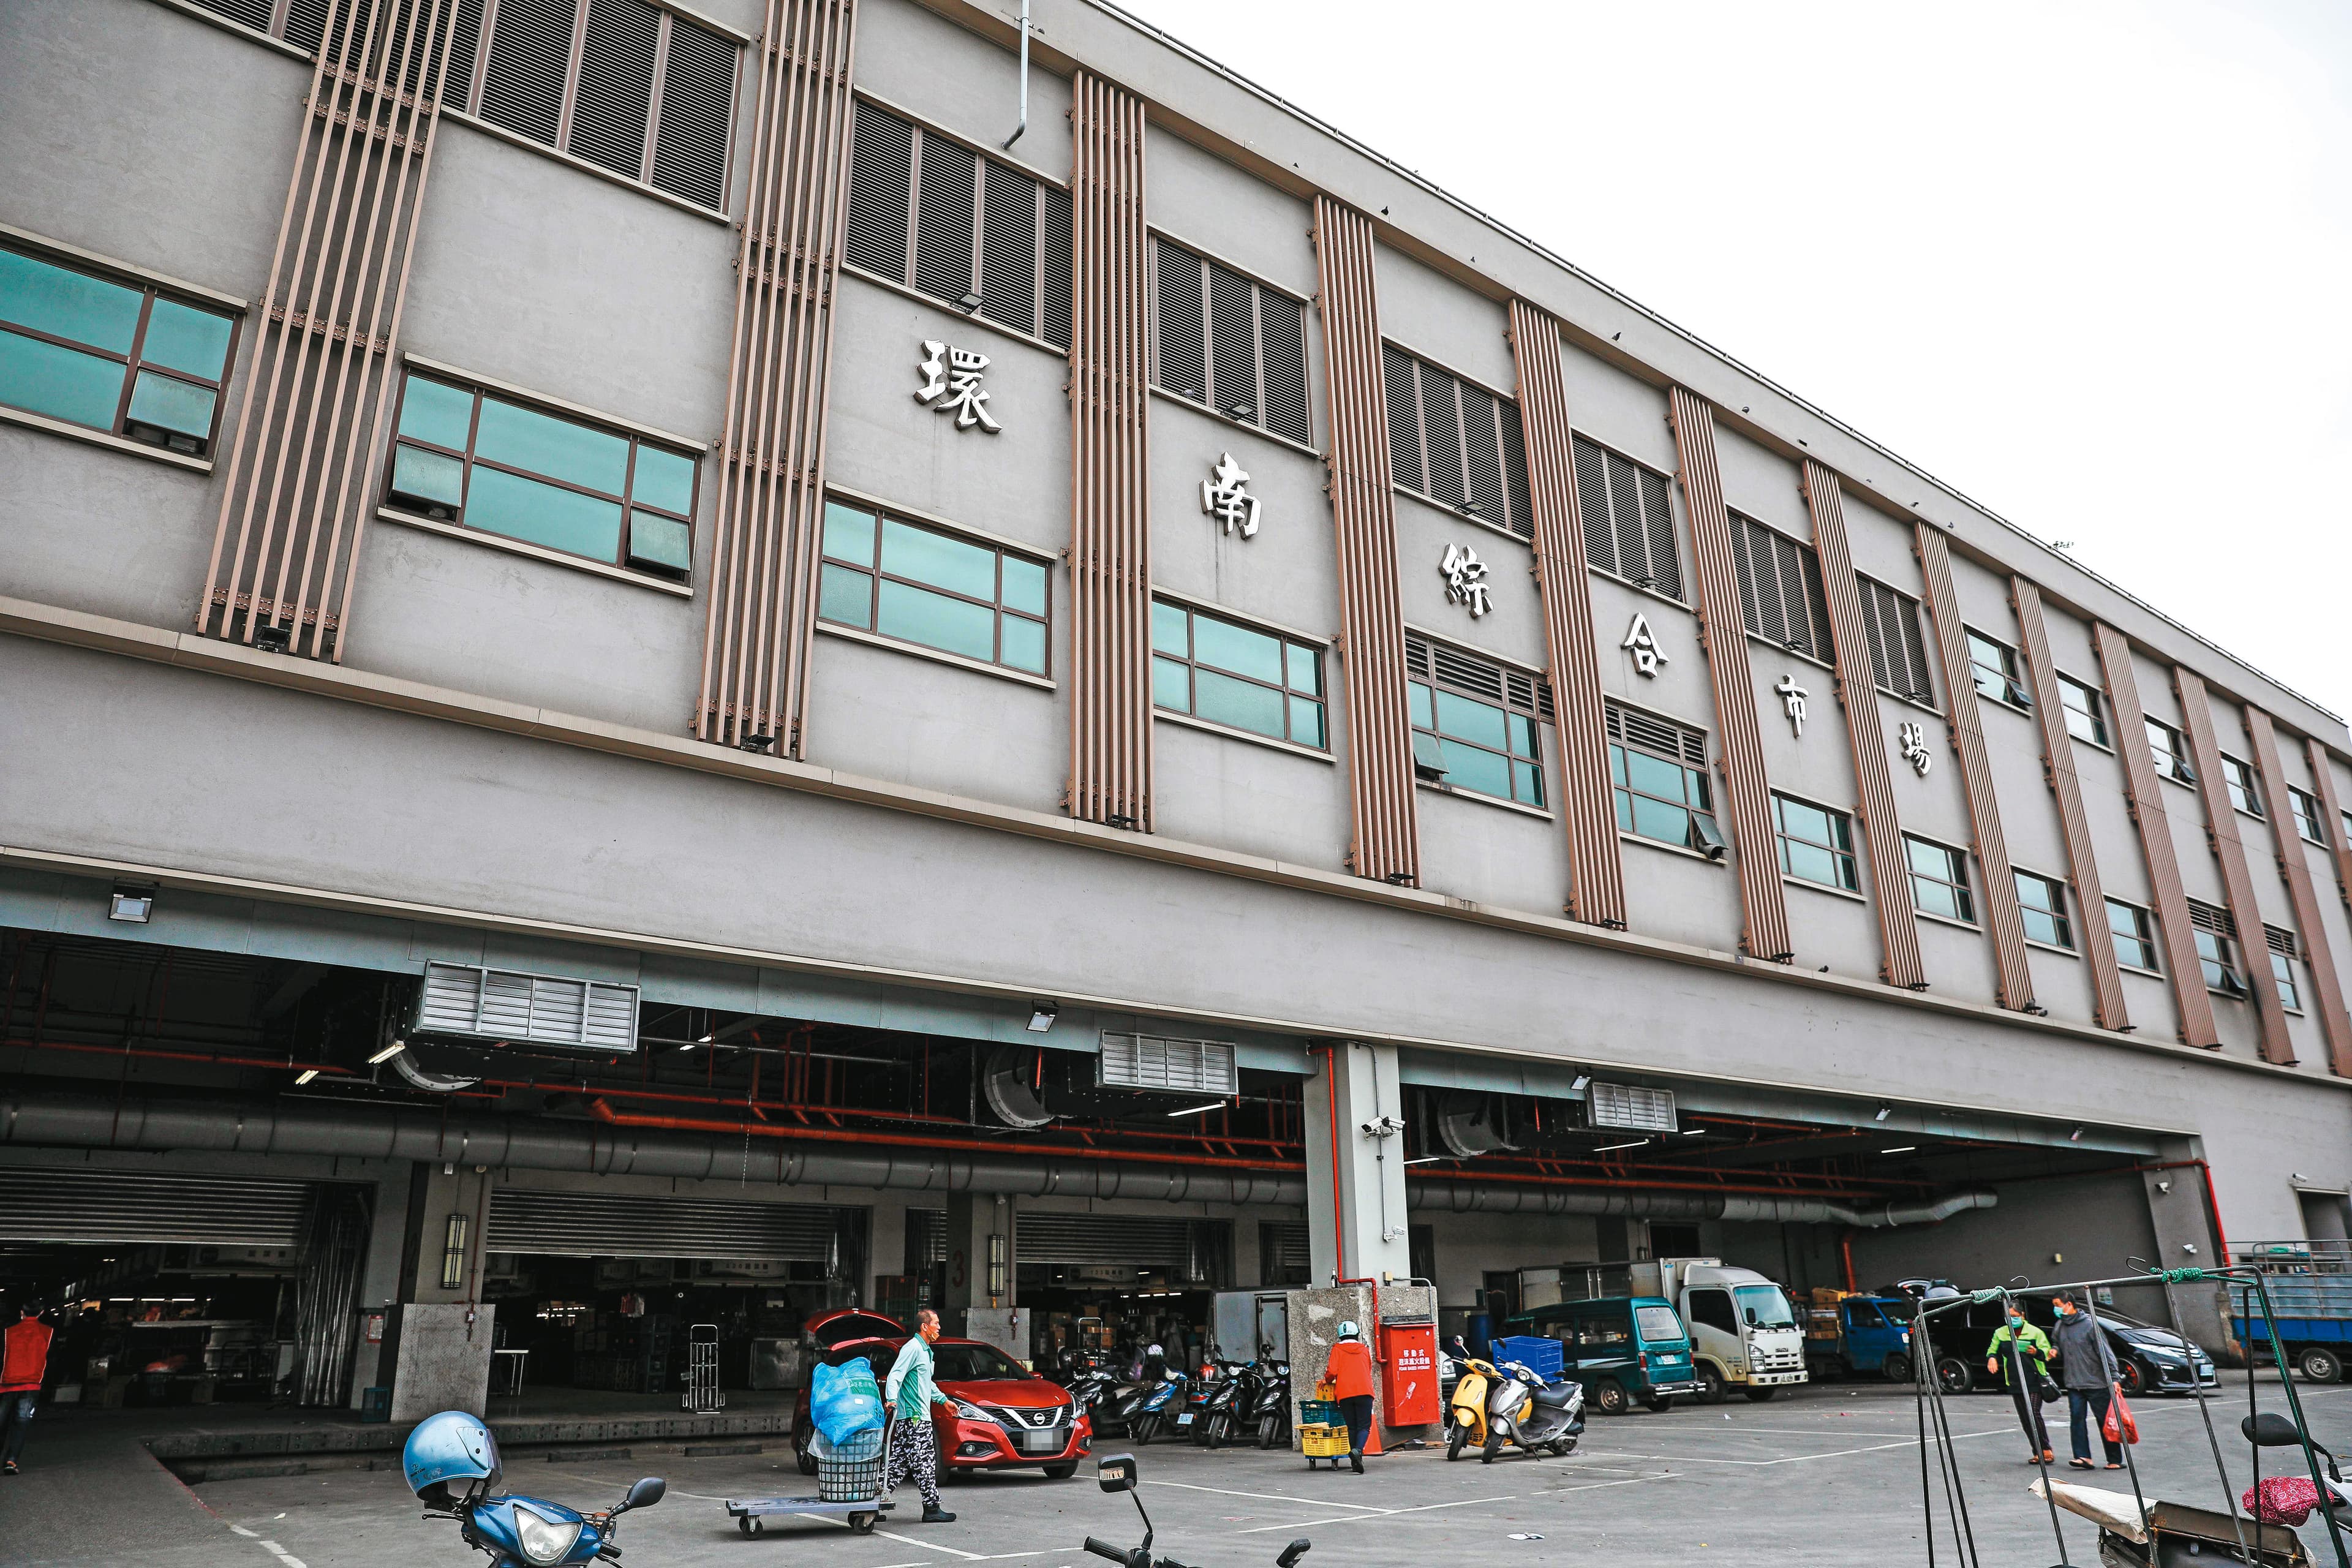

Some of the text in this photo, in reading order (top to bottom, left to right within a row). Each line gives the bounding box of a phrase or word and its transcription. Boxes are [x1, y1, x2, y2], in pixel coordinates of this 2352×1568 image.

[913, 339, 1932, 777] 環南綜合市場
[952, 1250, 965, 1287] 3
